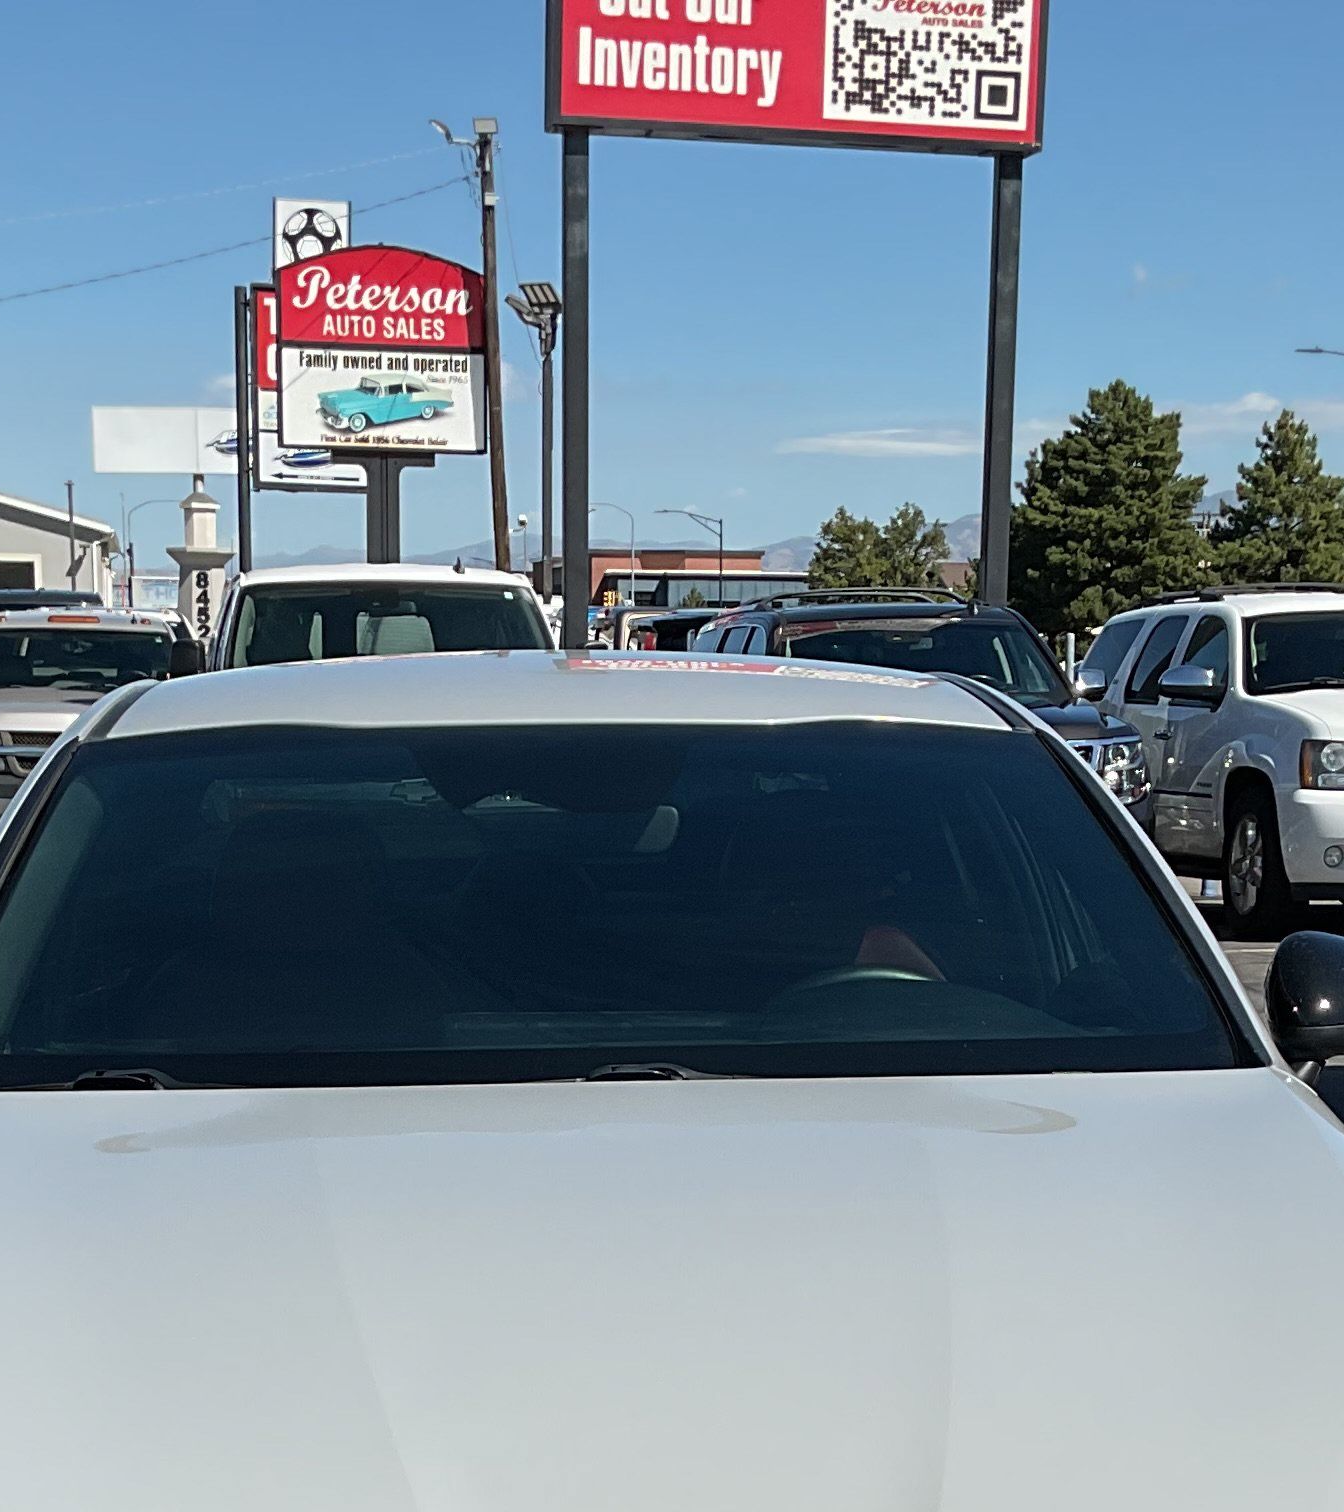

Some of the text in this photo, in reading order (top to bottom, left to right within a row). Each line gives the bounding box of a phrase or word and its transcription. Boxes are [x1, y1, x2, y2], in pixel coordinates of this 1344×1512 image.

[921, 17, 984, 29] AUTO SALES
[577, 26, 783, 108] Inventory
[292, 265, 473, 317] Peterson
[322, 314, 446, 341] AUTO SALES
[299, 350, 339, 372] Family
[343, 353, 383, 371] owned
[387, 354, 409, 372] and
[414, 355, 469, 374] operated
